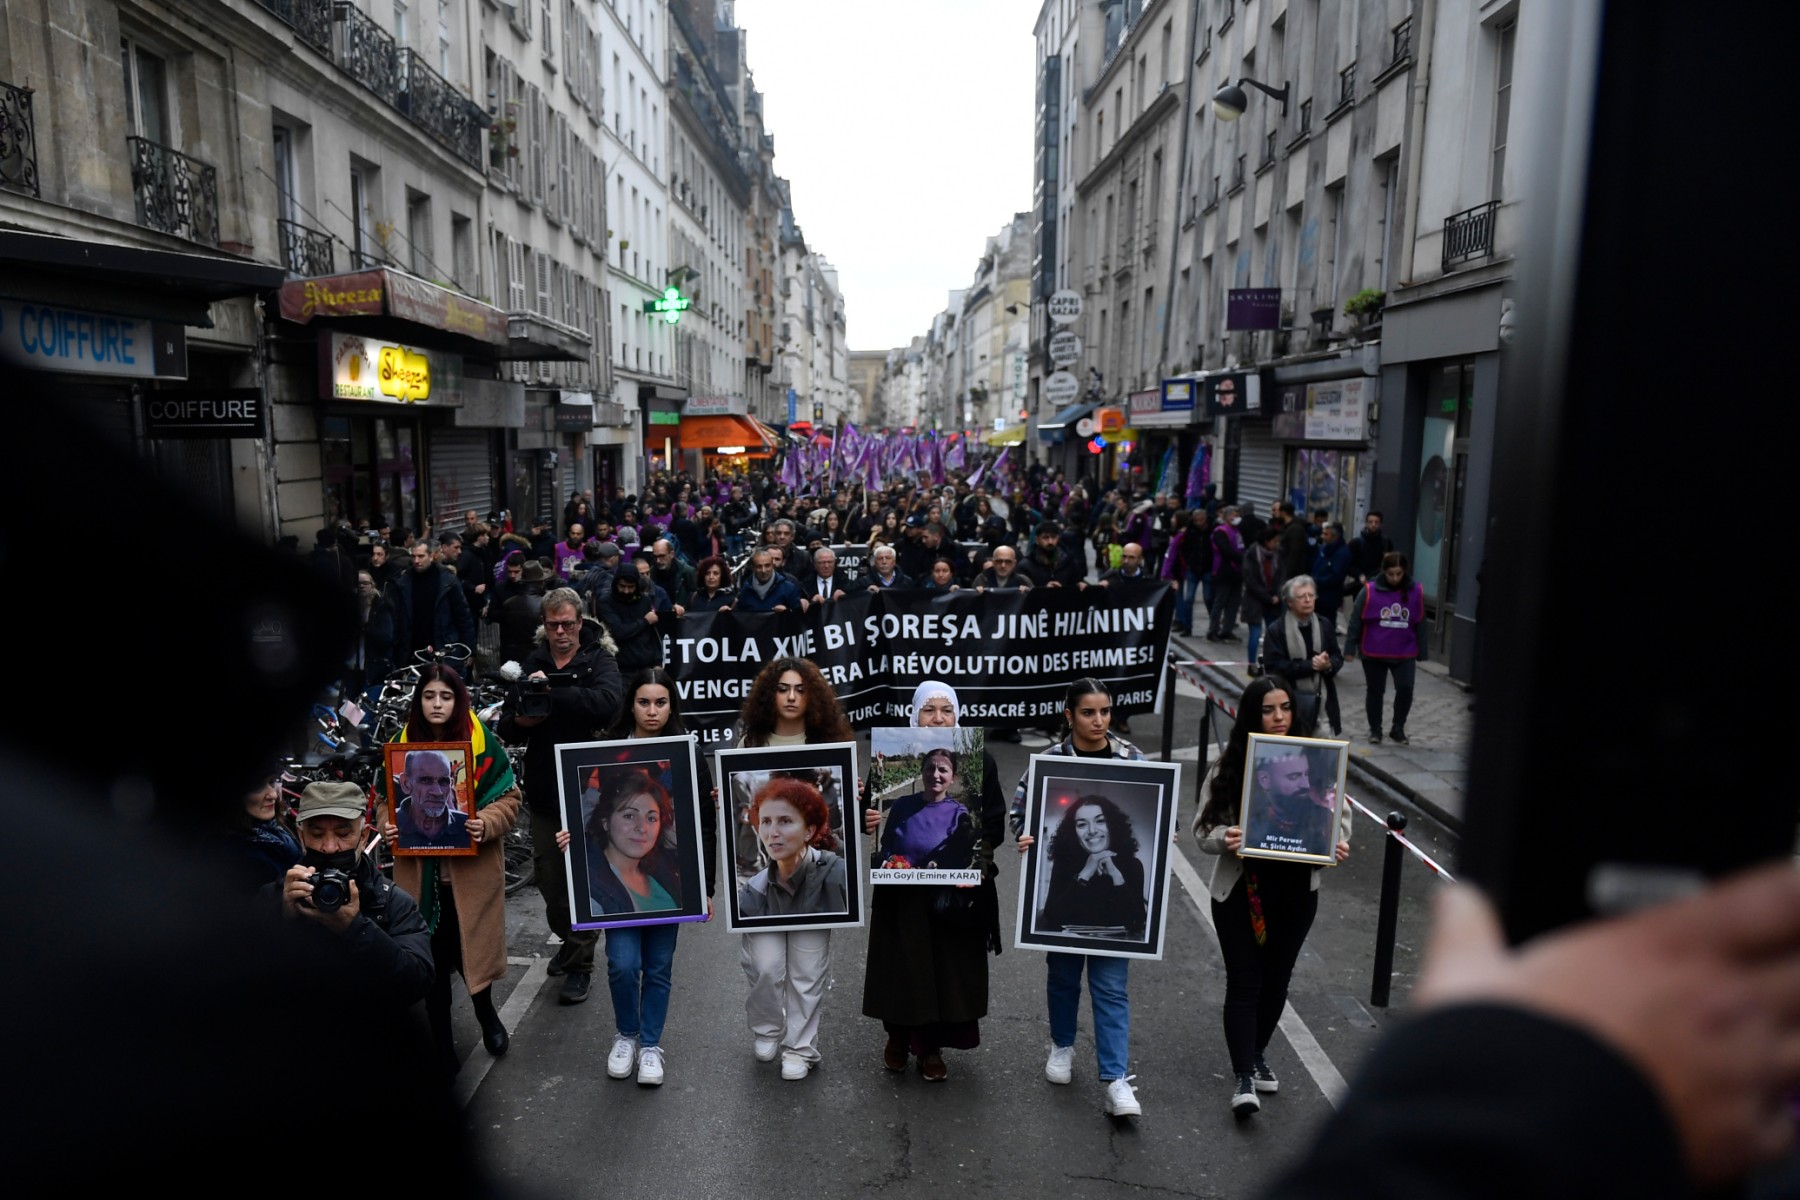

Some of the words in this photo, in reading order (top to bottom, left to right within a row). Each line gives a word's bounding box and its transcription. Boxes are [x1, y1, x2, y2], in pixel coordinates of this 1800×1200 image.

[302, 281, 382, 317] Sheeza
[1051, 298, 1080, 306] CAPRI
[1052, 307, 1080, 316] BAZAR
[20, 305, 135, 365] COIFFURE
[1014, 356, 1023, 398] HOTEL
[335, 383, 375, 399] RESTAURANT
[150, 401, 257, 419] COIFFURE
[689, 398, 729, 407] ALIMENTATION
[1283, 392, 1296, 413] CITY
[676, 637, 762, 664] TOLA
[823, 621, 856, 650] BI
[864, 613, 982, 647] ŞOREŞA
[991, 608, 1049, 640] JINÊ
[1054, 606, 1154, 637] HILÎNIN!
[675, 679, 753, 700] VENGE
[819, 661, 864, 686] ERA
[868, 654, 889, 676] LA
[893, 651, 1038, 675] RÉVOLUTION
[1043, 652, 1070, 673] DES
[1072, 645, 1154, 670] FEMMES!
[703, 729, 720, 743] LE
[723, 728, 733, 741] 9
[848, 703, 881, 723] TURC
[960, 701, 1026, 717] ASSACRÉ
[1029, 704, 1037, 717] 3
[1040, 702, 1054, 716] DE
[1117, 690, 1153, 706] PARIS
[1279, 836, 1303, 844] Perwer
[872, 871, 891, 879] Evin
[893, 871, 915, 881] Goyî
[916, 872, 948, 881] (Emine
[949, 873, 980, 881] KARA)
